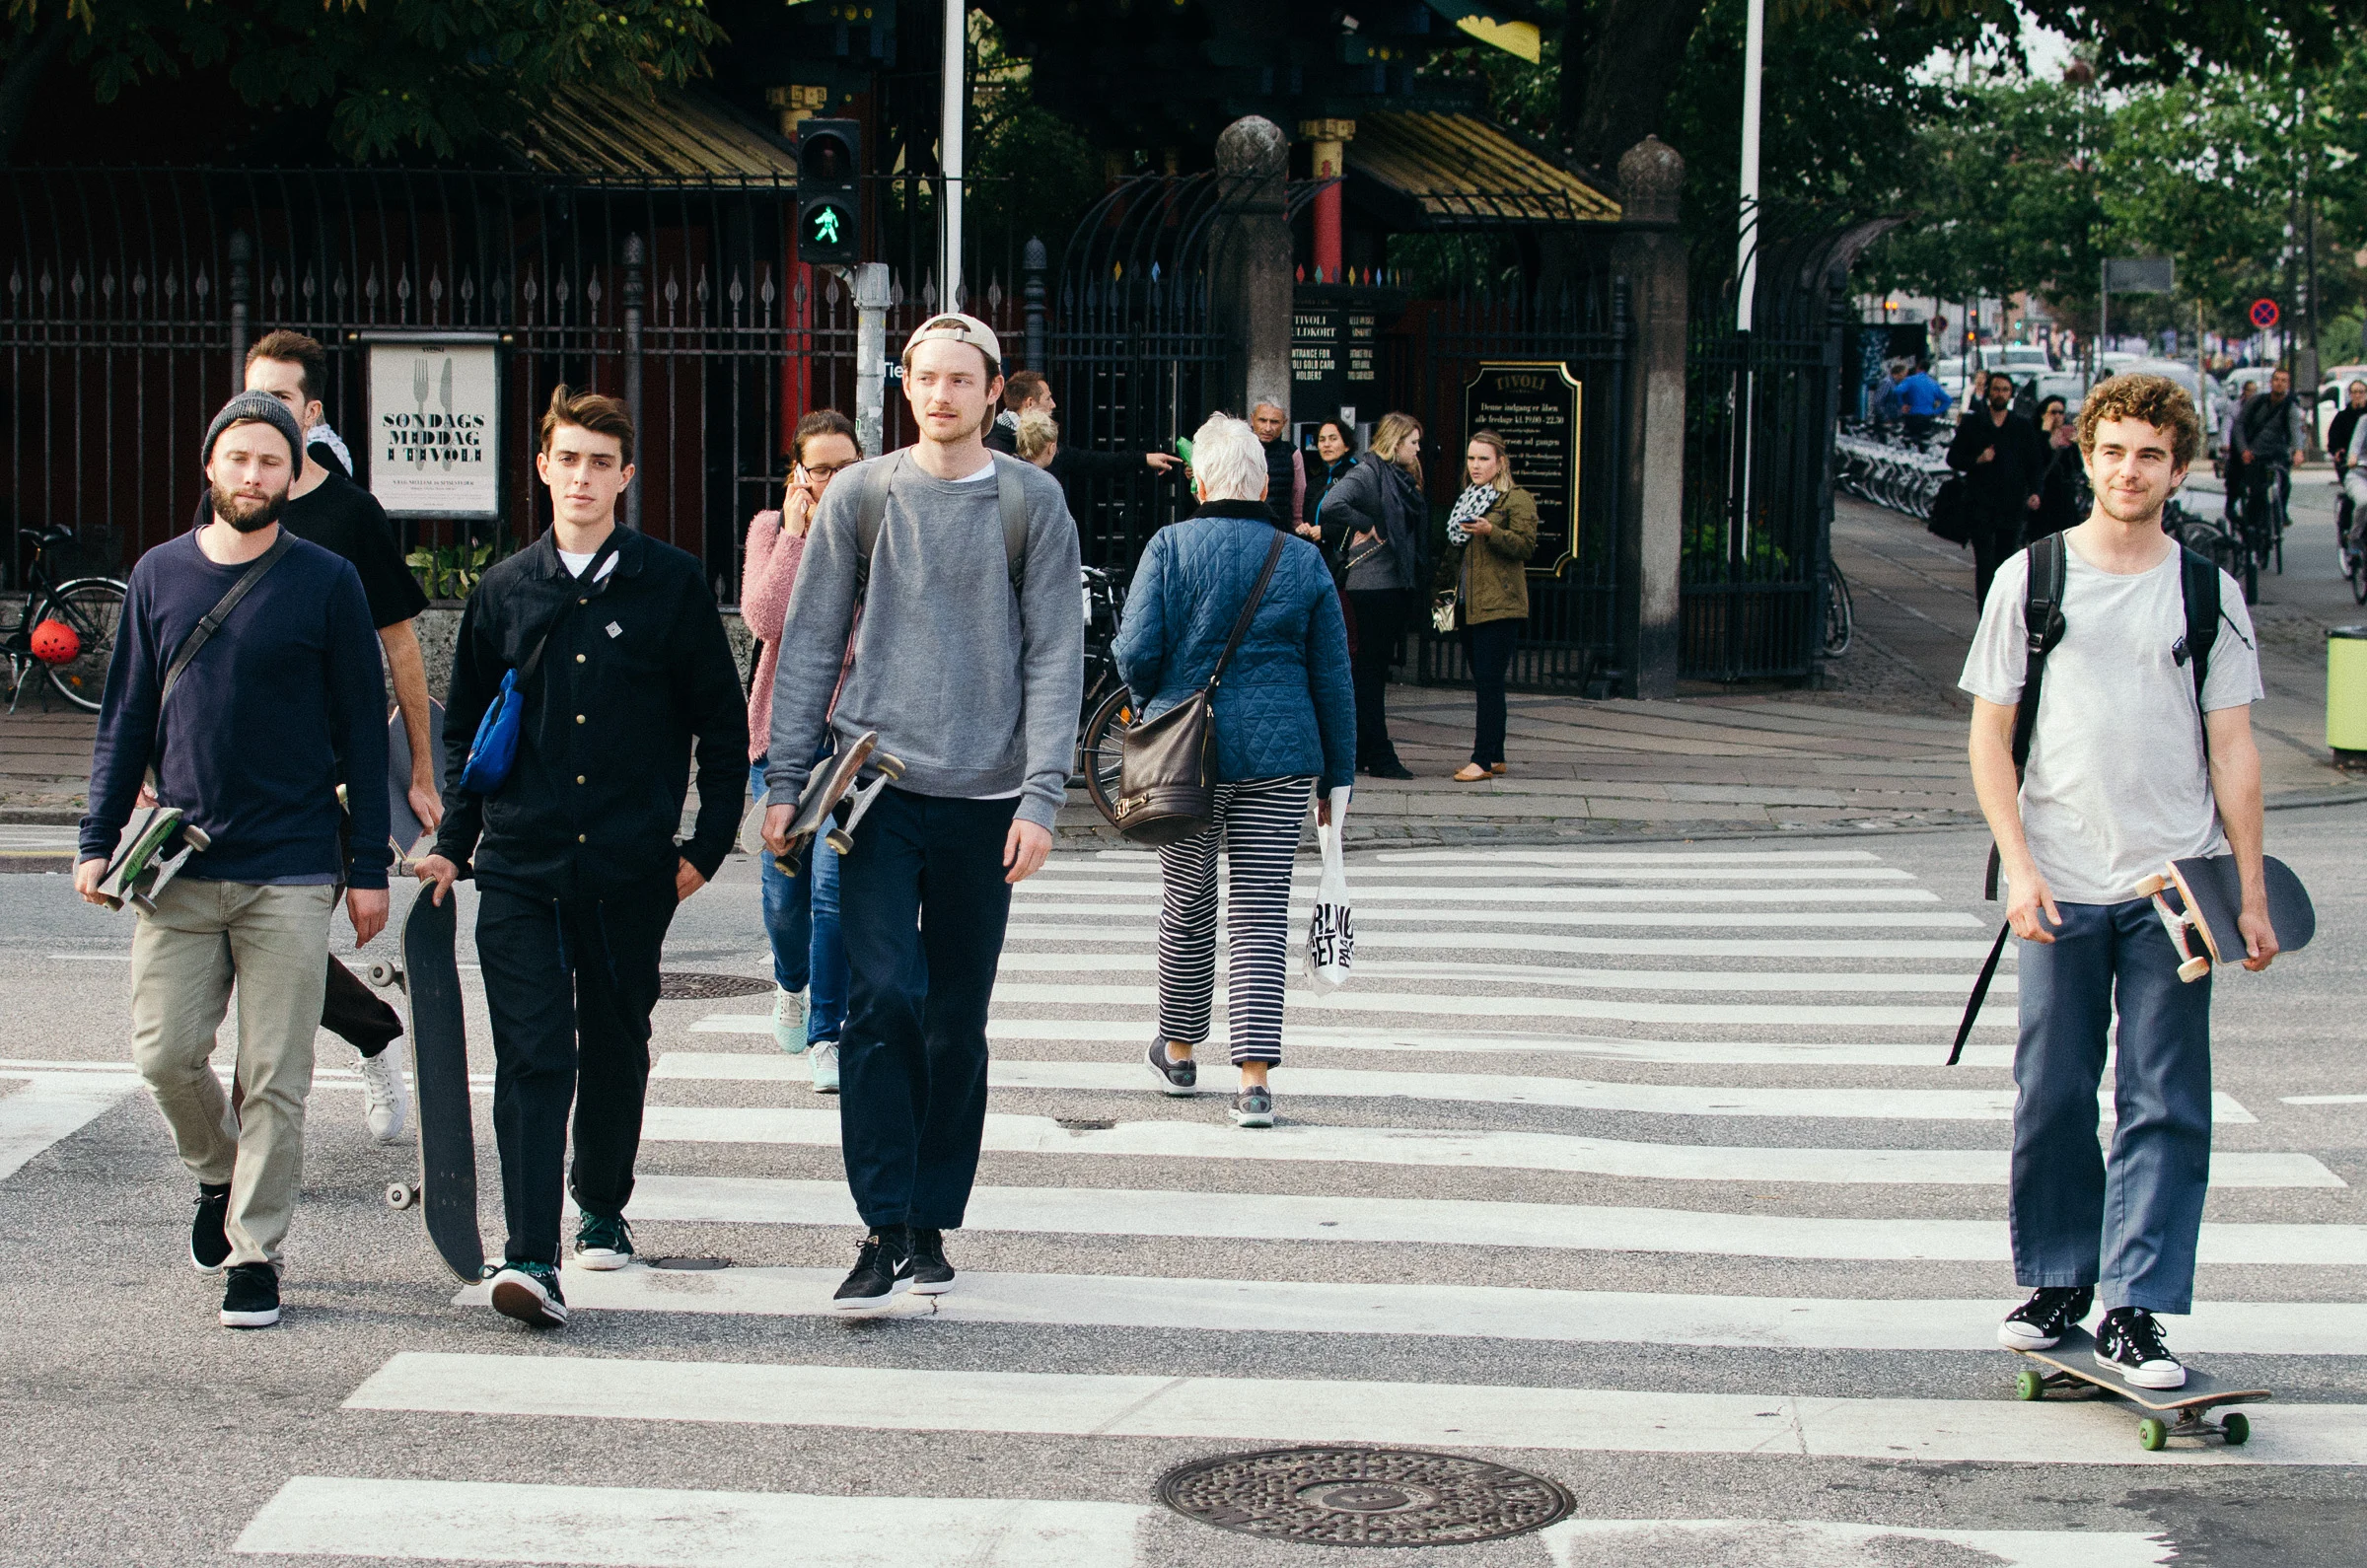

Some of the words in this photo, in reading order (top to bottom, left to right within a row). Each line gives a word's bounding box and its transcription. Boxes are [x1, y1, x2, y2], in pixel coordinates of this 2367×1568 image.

[1294, 315, 1327, 325] TIVOLI
[1291, 326, 1337, 337] ULDKORT
[1291, 348, 1318, 359] NTRANCE
[1319, 348, 1330, 359] FOR
[884, 361, 903, 378] Tie
[1292, 360, 1302, 370] OLI
[1303, 359, 1318, 370] GOLD
[1320, 359, 1335, 370] CARD
[1295, 370, 1323, 381] HOLDERS
[1496, 375, 1546, 391] TIVOLI
[1480, 402, 1503, 411] Denne
[389, 430, 479, 446] MIDDAG
[388, 448, 395, 462] I
[402, 448, 482, 462] TIVOLI
